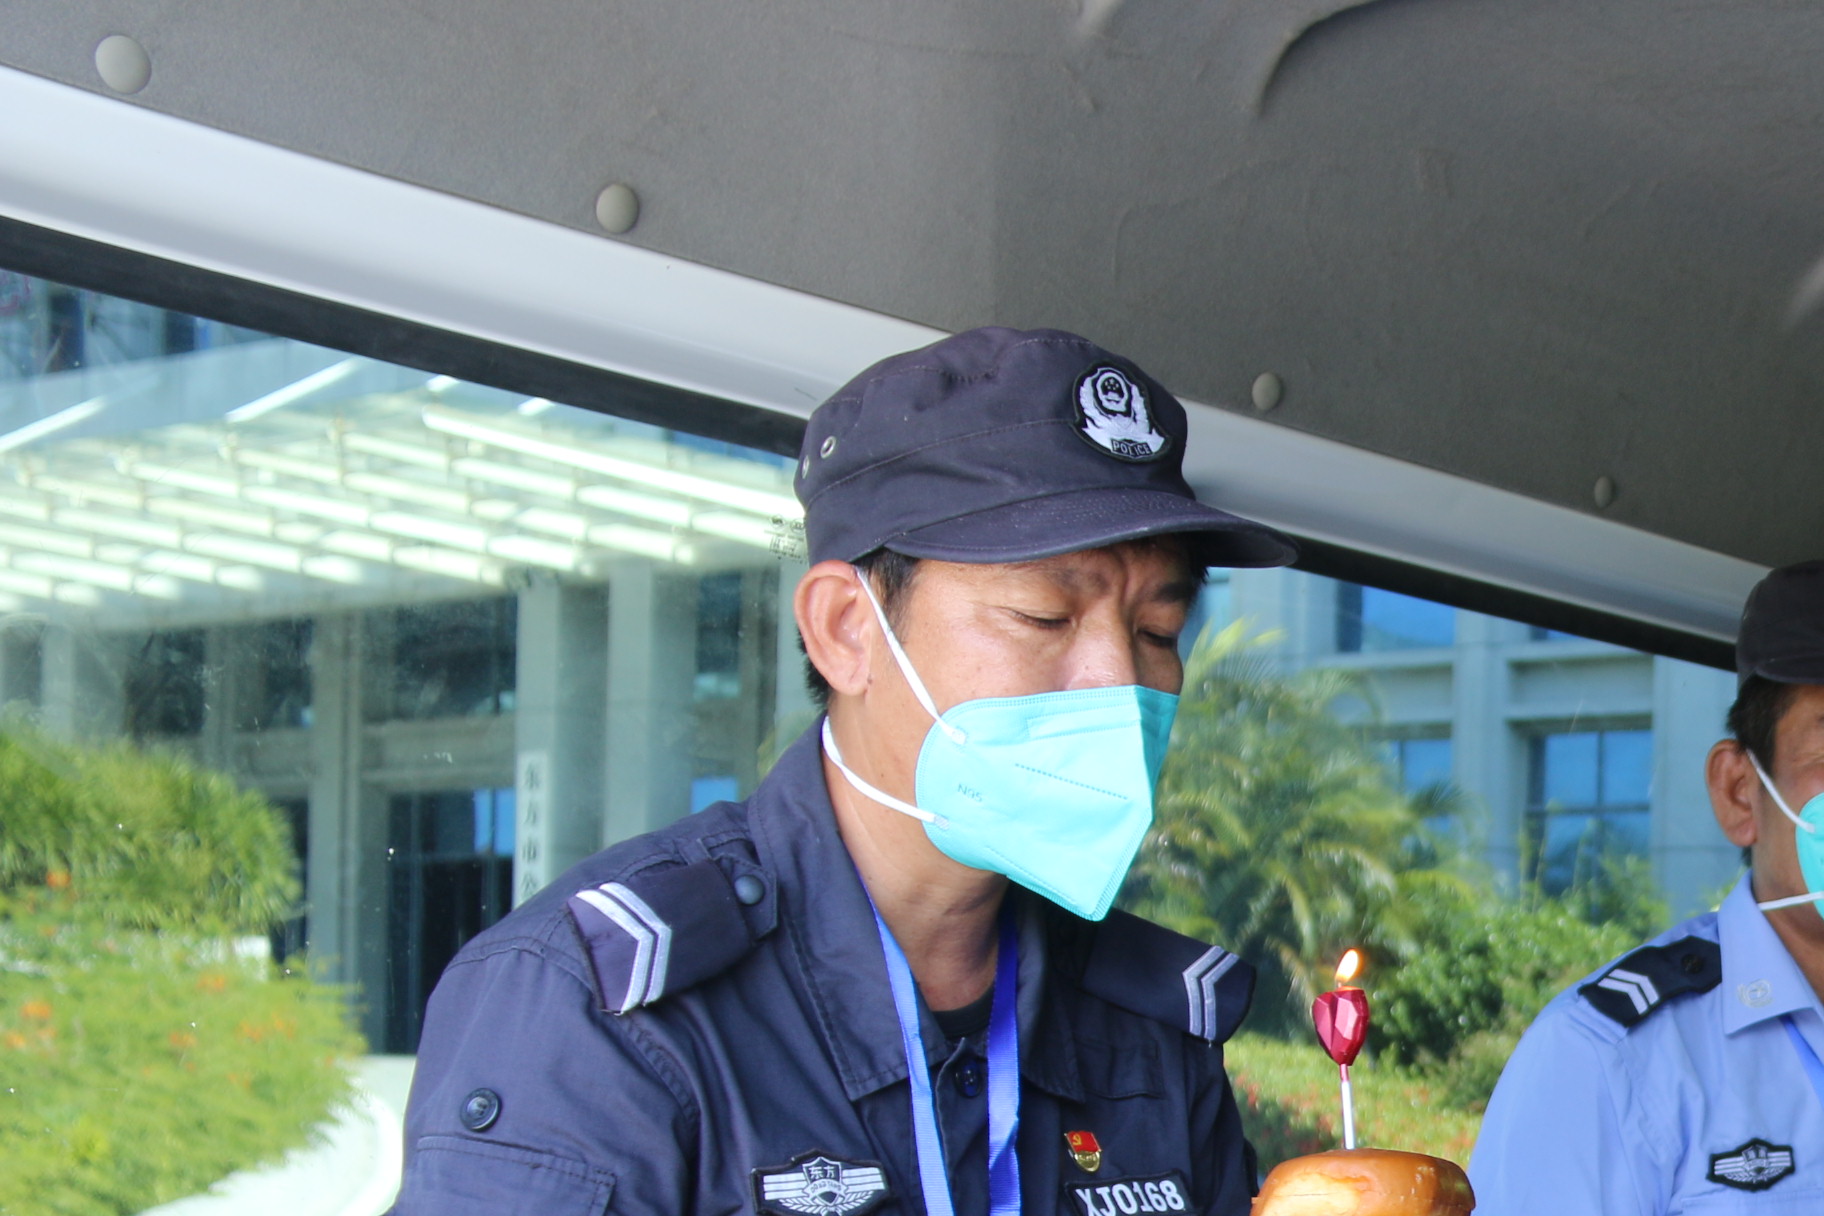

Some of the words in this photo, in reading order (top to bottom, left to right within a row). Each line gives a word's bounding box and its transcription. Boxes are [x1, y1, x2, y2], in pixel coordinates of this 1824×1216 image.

[1111, 440, 1152, 456] POLICE
[957, 783, 984, 803] N95
[808, 1166, 835, 1179] 东方
